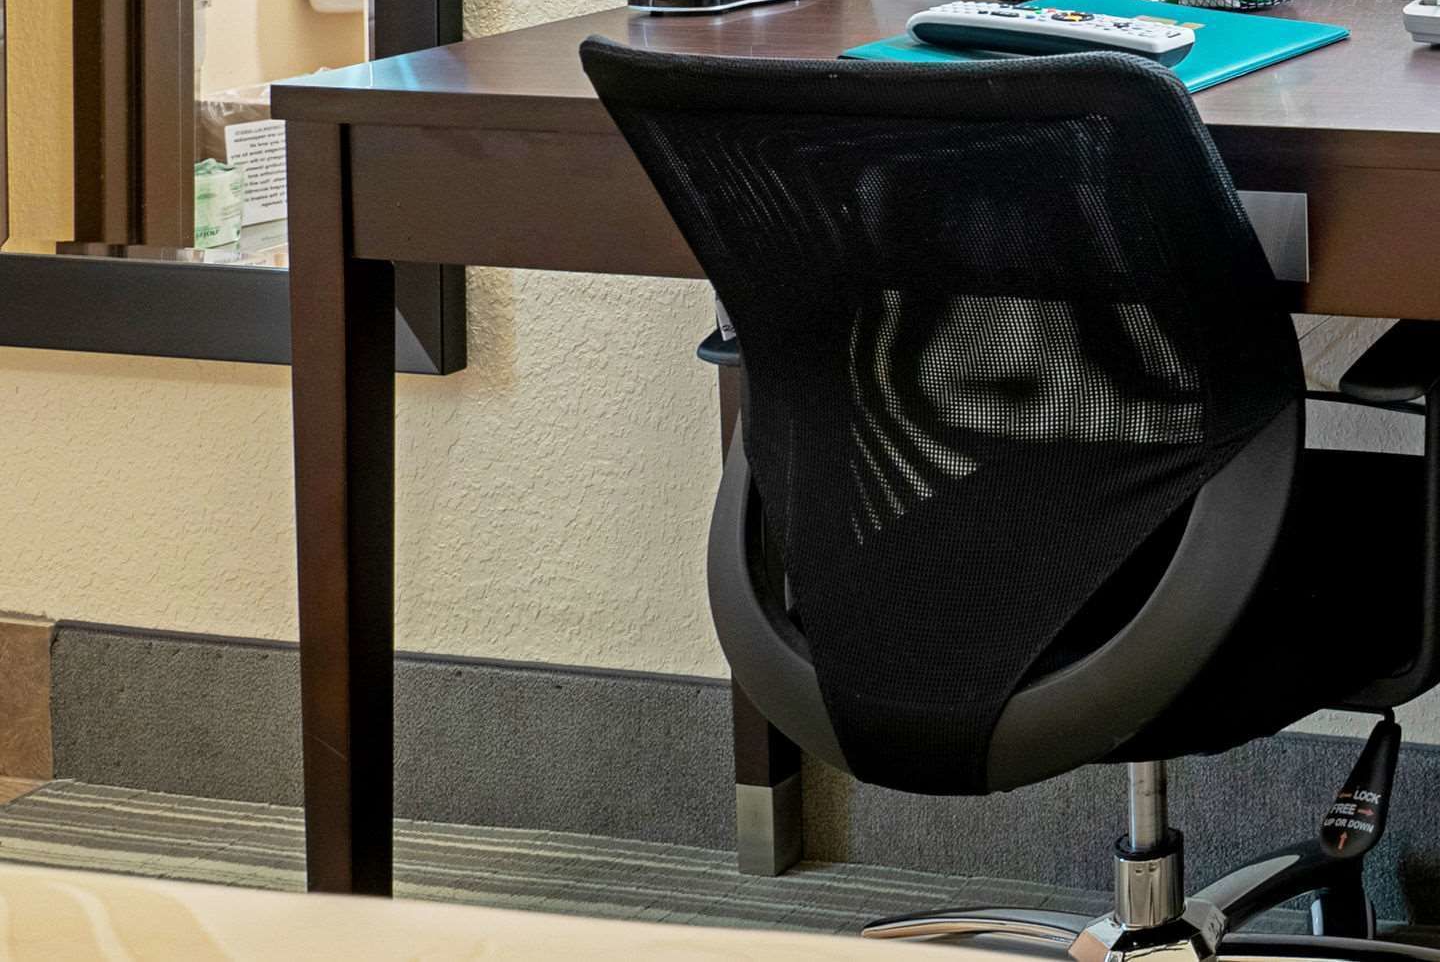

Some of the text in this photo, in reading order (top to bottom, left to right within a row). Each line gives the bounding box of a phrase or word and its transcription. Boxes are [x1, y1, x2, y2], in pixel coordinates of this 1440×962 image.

[1353, 790, 1381, 805] LOCK
[1330, 803, 1357, 815] FREE
[1335, 819, 1347, 827] OR
[1347, 820, 1374, 833] DOWN
